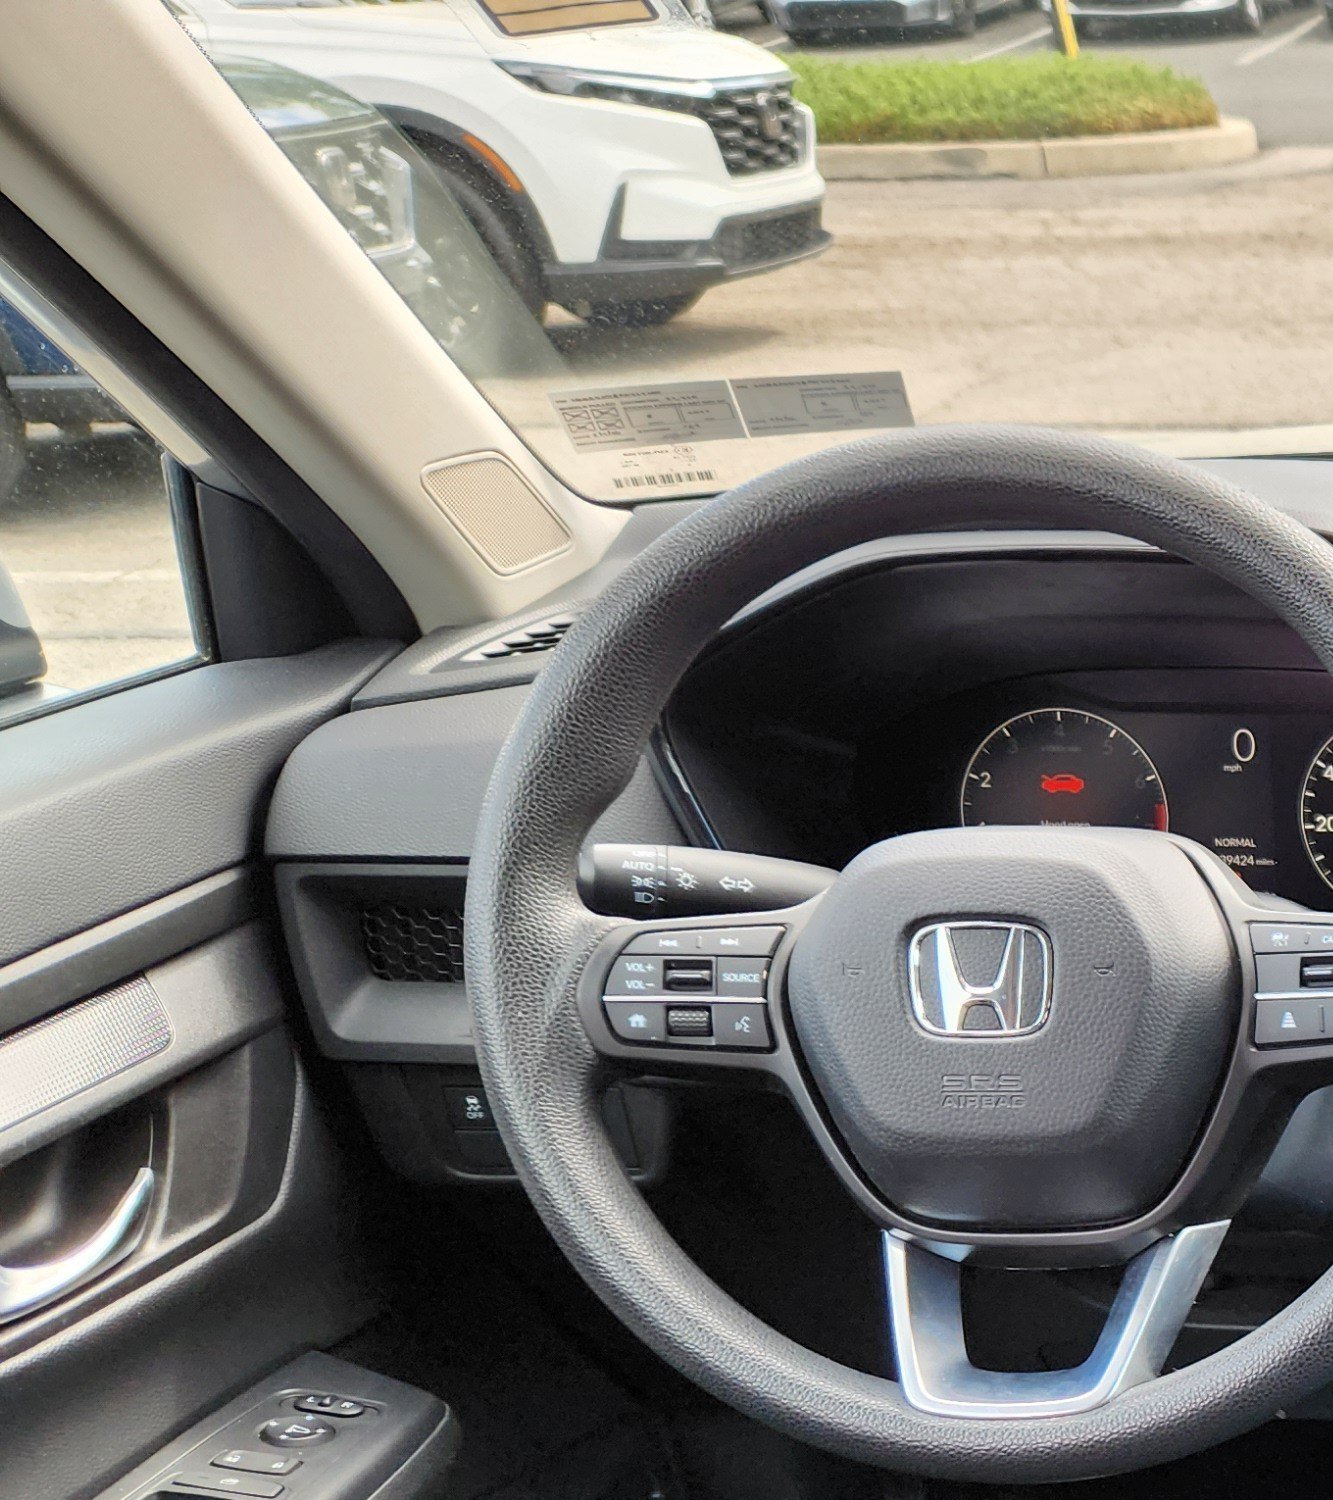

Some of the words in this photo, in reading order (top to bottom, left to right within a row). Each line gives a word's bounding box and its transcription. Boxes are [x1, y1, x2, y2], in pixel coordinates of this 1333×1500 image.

[1233, 728, 1256, 763] 0
[1223, 764, 1242, 773] mph
[980, 771, 992, 789] 2
[1215, 838, 1256, 848] NORMAL
[622, 860, 655, 872] AUTO
[722, 972, 760, 983] SOURCE
[941, 1073, 1024, 1091] SRS
[941, 1094, 1028, 1109] AIRBAG
